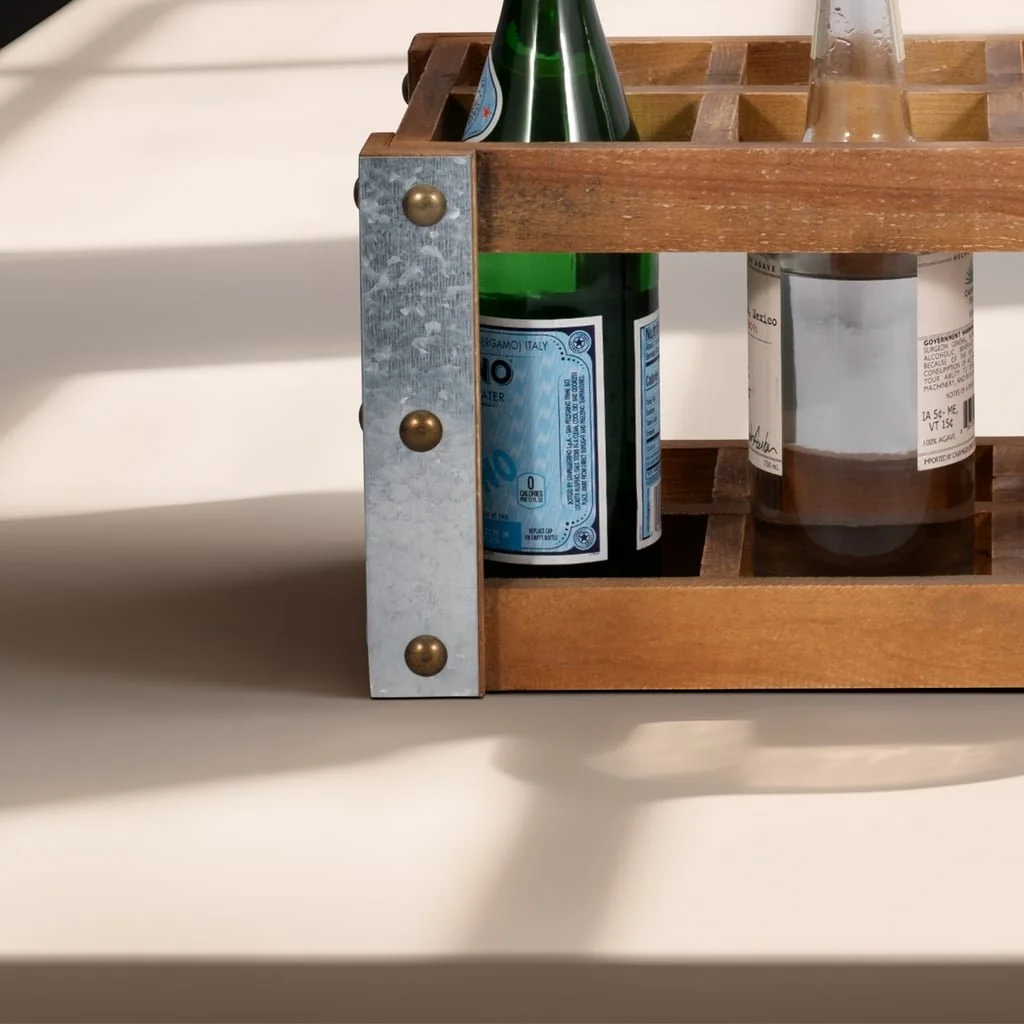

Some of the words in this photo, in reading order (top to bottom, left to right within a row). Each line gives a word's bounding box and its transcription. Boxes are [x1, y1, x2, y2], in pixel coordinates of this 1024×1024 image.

[525, 340, 548, 350] ITALY
[929, 420, 939, 432] VT
[527, 476, 535, 490] 0
